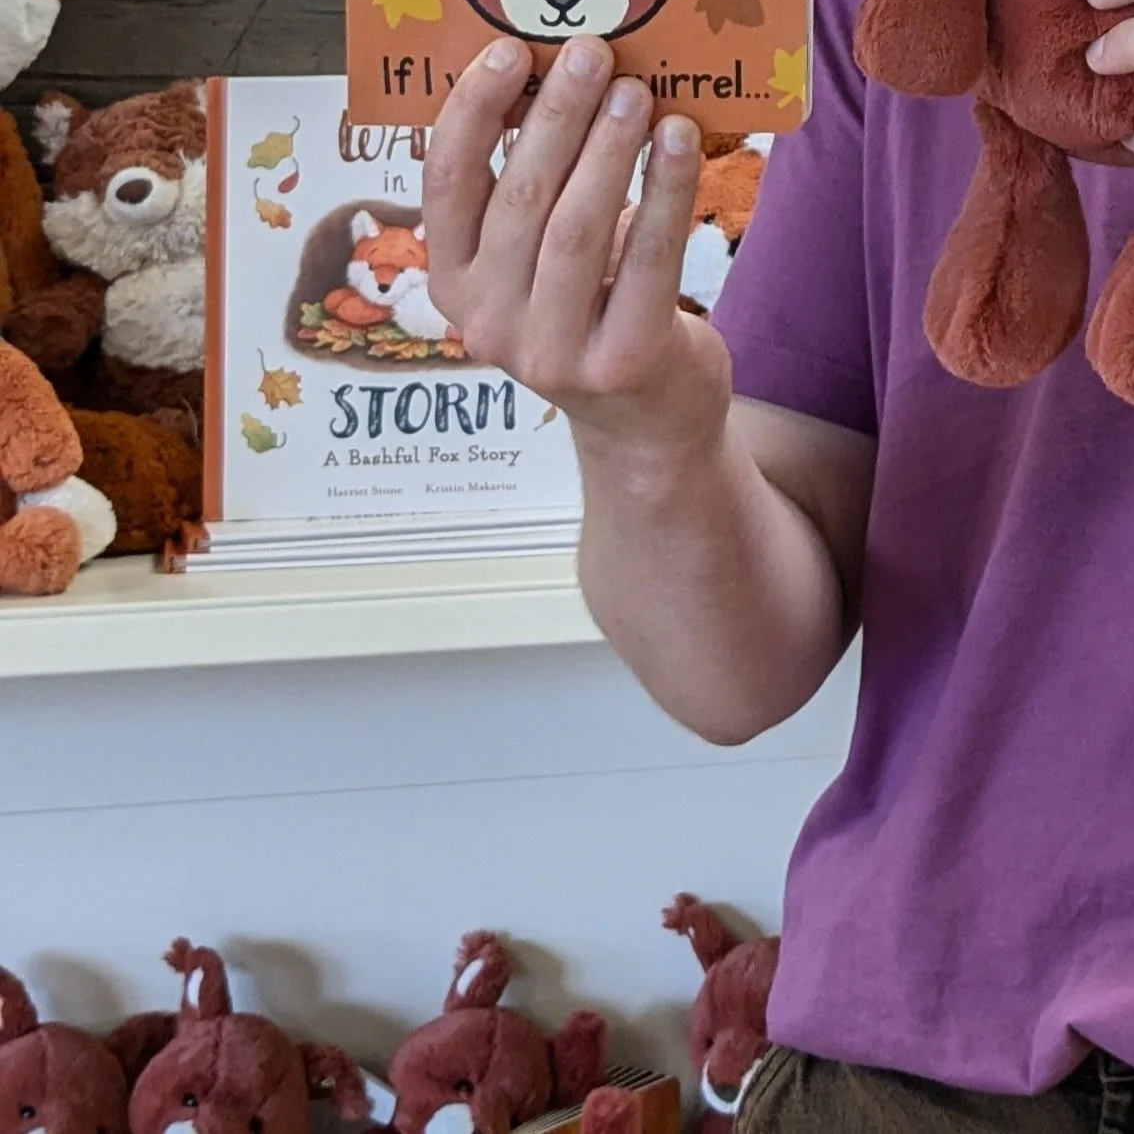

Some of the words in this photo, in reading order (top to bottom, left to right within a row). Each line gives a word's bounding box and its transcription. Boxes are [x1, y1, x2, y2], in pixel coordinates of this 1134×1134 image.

[383, 56, 414, 96] If
[635, 60, 770, 99] uirrel...
[383, 170, 407, 193] in
[329, 380, 516, 438] STORM
[323, 450, 340, 468] A
[348, 445, 420, 466] Bashful
[428, 446, 460, 464] Fox
[468, 444, 522, 466] Story
[327, 486, 369, 498] Harriet
[371, 485, 404, 496] Stone
